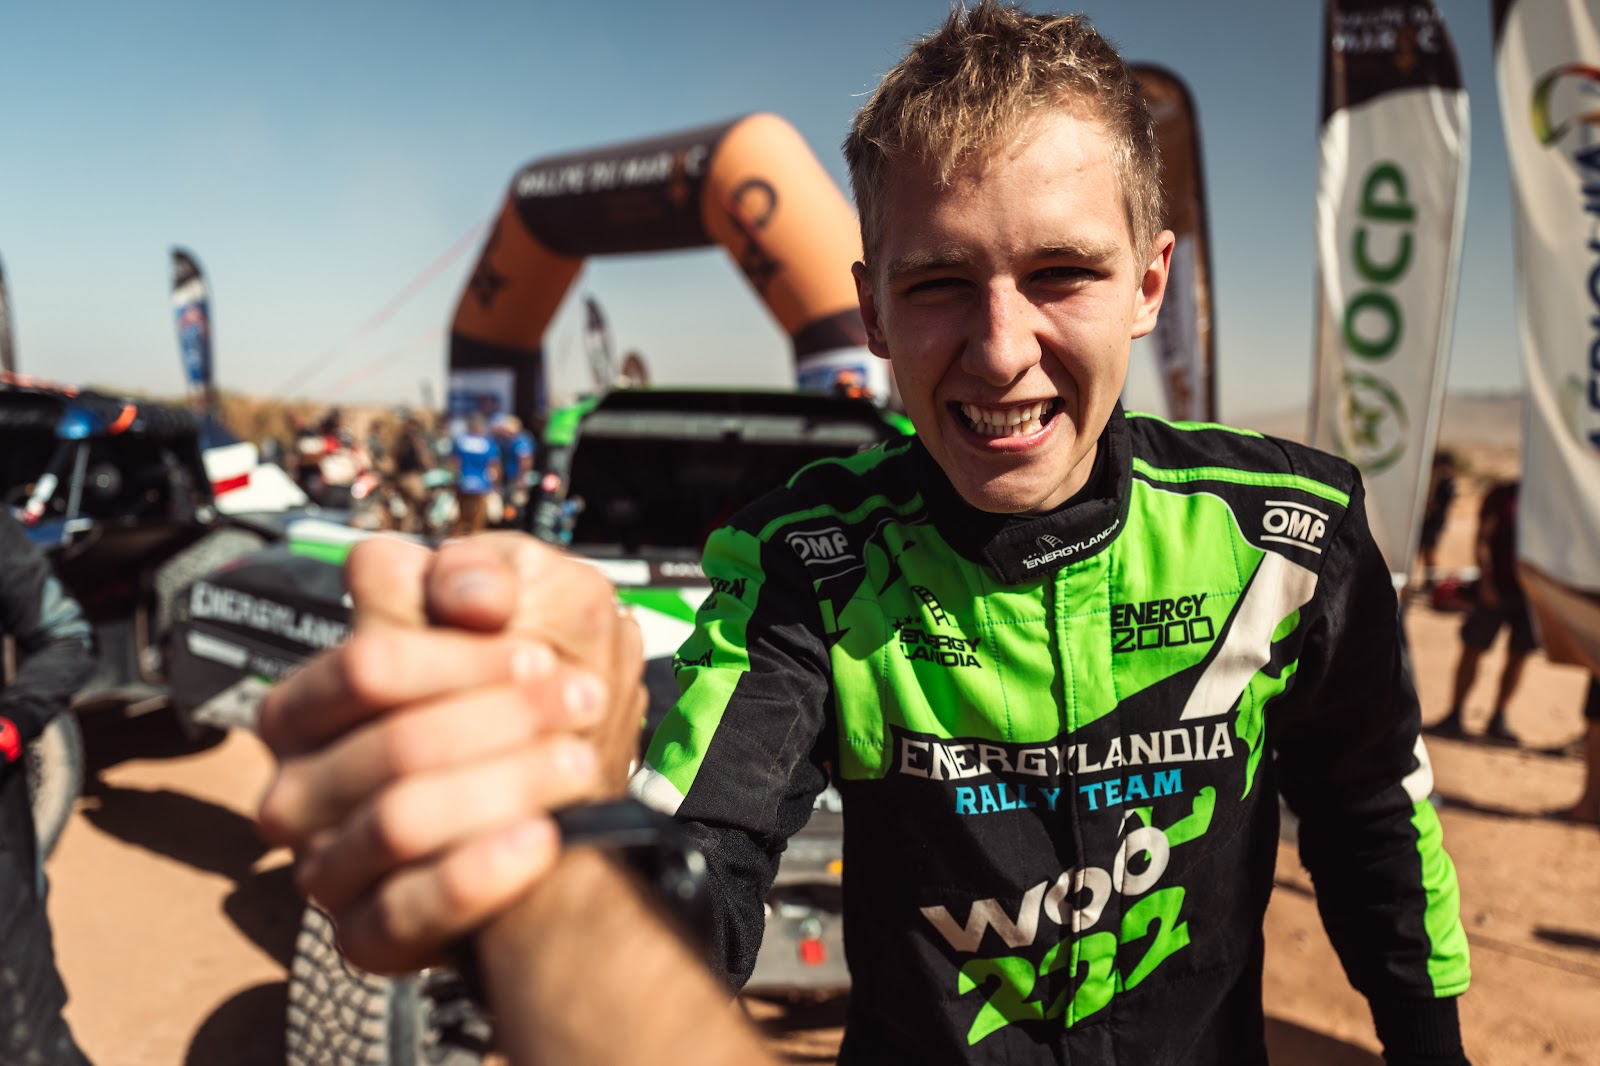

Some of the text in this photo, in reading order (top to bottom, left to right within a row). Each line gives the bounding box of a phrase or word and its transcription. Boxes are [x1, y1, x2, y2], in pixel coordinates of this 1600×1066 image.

[1342, 161, 1417, 361] OCP
[1026, 518, 1120, 570] ENERGYLANDIA
[1262, 508, 1327, 544] OMP
[790, 531, 849, 560] OMP
[1112, 593, 1208, 628] ENERGY
[900, 628, 982, 653] ENERGY
[1112, 616, 1215, 654] 2000
[900, 645, 982, 669] LANDIA
[899, 721, 1235, 781] ENERGYLANDIA
[955, 768, 1184, 815] RALLY TEAM
[958, 886, 1191, 1046] 222
